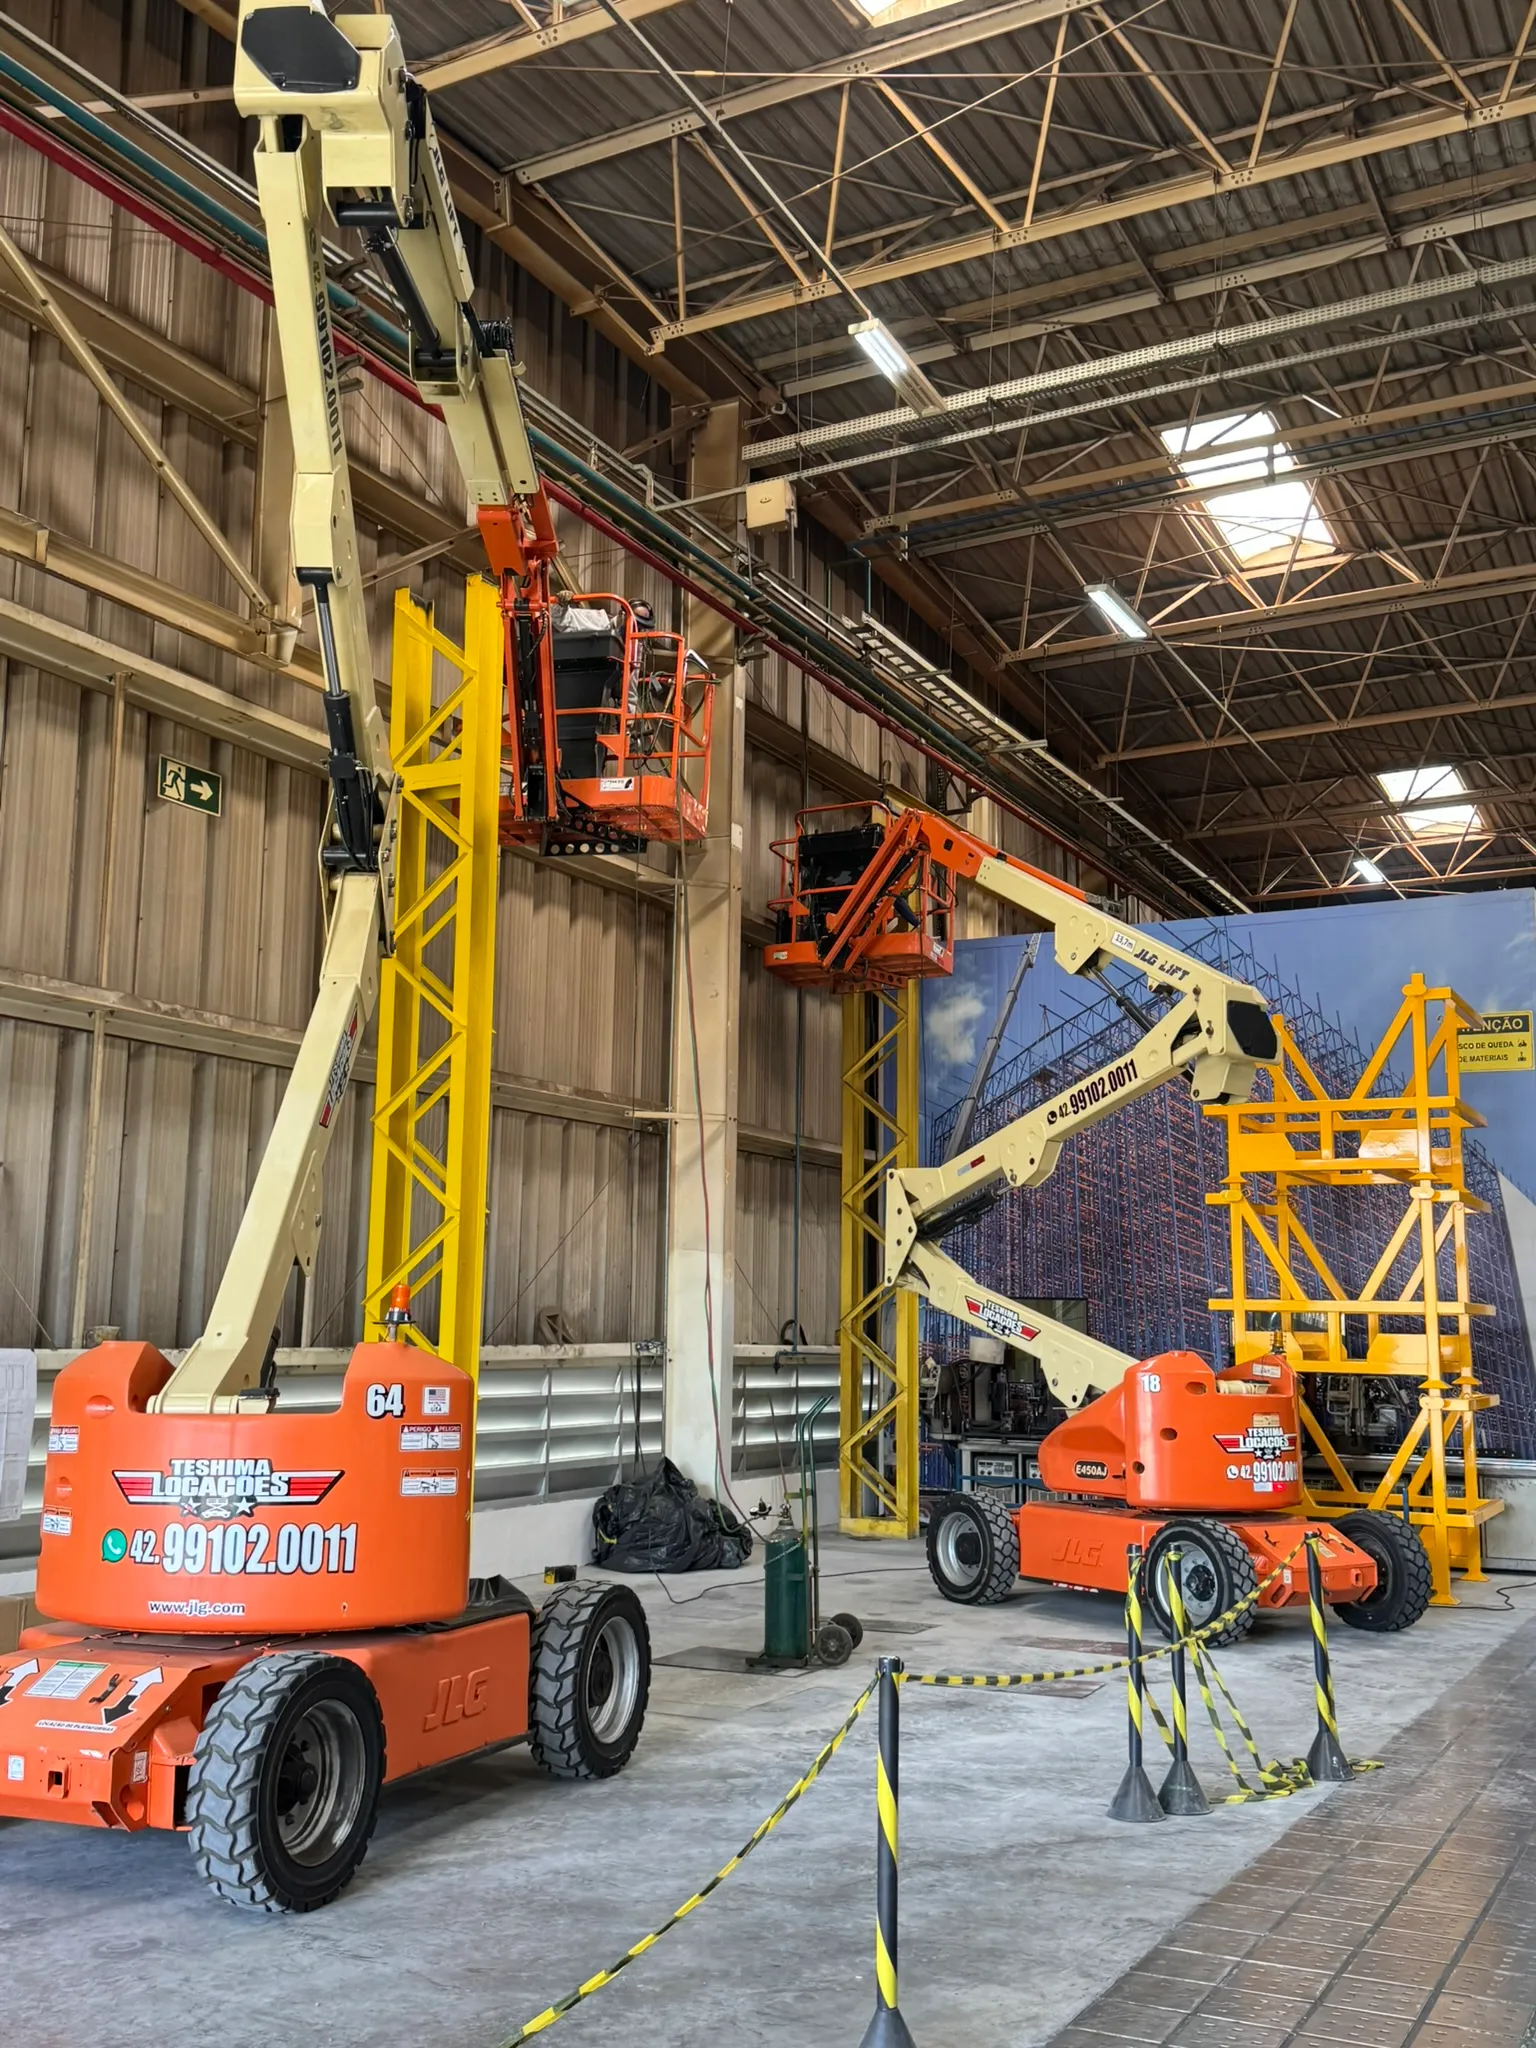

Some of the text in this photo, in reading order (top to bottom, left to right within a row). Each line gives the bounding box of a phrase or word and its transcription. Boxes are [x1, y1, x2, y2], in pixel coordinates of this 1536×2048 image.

[1134, 948, 1191, 981] JLG LIFT
[1462, 1016, 1523, 1033] NÇÃO
[1458, 1042, 1474, 1050] SCO
[1487, 1041, 1514, 1049] QUEDA
[1469, 1054, 1509, 1063] MATERIAIS
[987, 1301, 1018, 1320] TESHIMA
[1140, 1373, 1161, 1393] 18
[366, 1383, 405, 1418] 64
[1247, 1427, 1284, 1437] TESHIMA
[170, 1459, 271, 1476] TESHIMA
[1076, 1464, 1107, 1477] E450AJ
[1051, 1537, 1104, 1568] JLG
[149, 1600, 245, 1616] www.jlg.com
[422, 1666, 490, 1733] JLG
